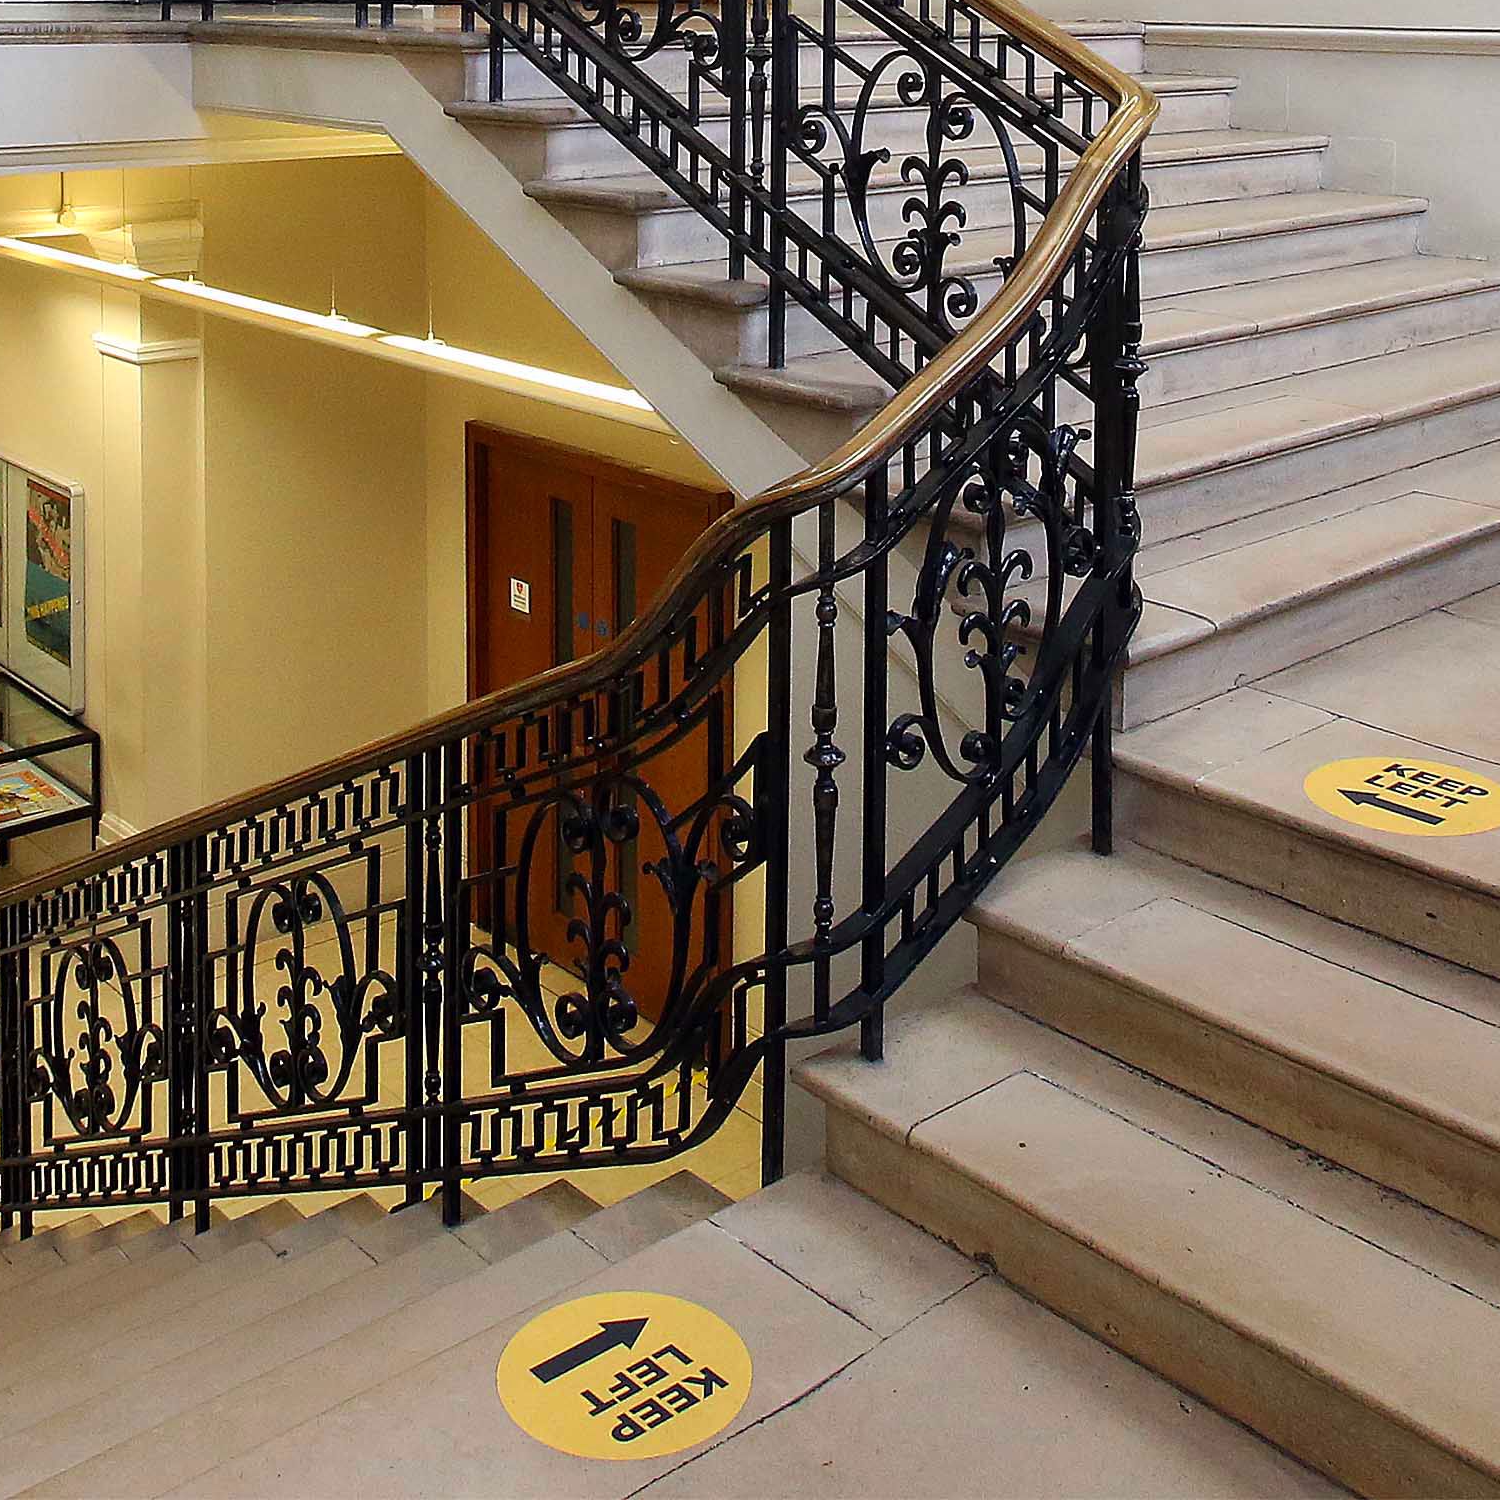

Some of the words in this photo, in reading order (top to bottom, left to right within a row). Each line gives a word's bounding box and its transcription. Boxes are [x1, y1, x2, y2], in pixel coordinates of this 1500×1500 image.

[1364, 774, 1468, 808] LEFT
[1383, 763, 1489, 797] KEEP
[580, 1344, 694, 1417] LEFT
[611, 1367, 729, 1442] KEEP
